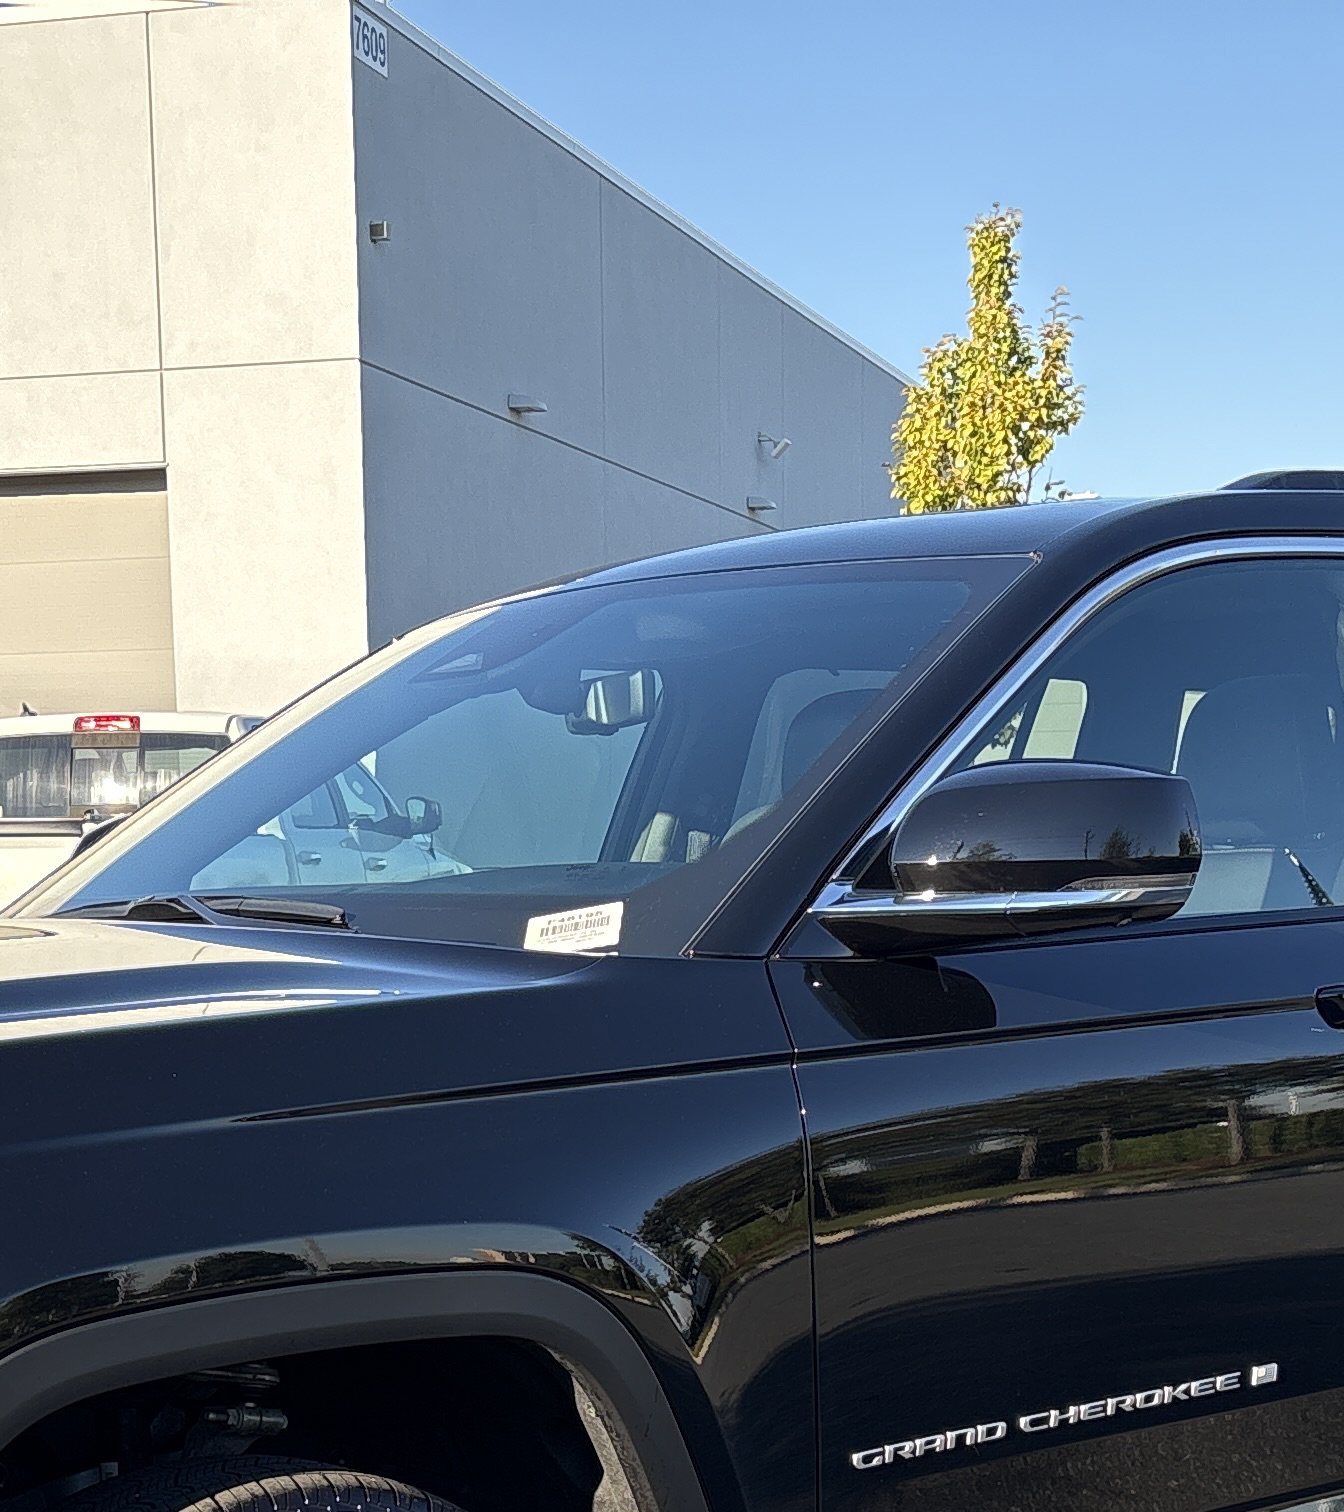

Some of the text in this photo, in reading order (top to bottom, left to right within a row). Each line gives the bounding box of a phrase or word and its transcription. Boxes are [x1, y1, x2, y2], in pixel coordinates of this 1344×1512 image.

[354, 14, 387, 68] 7609
[851, 1371, 1243, 1470] GRAND CHEROKEE
